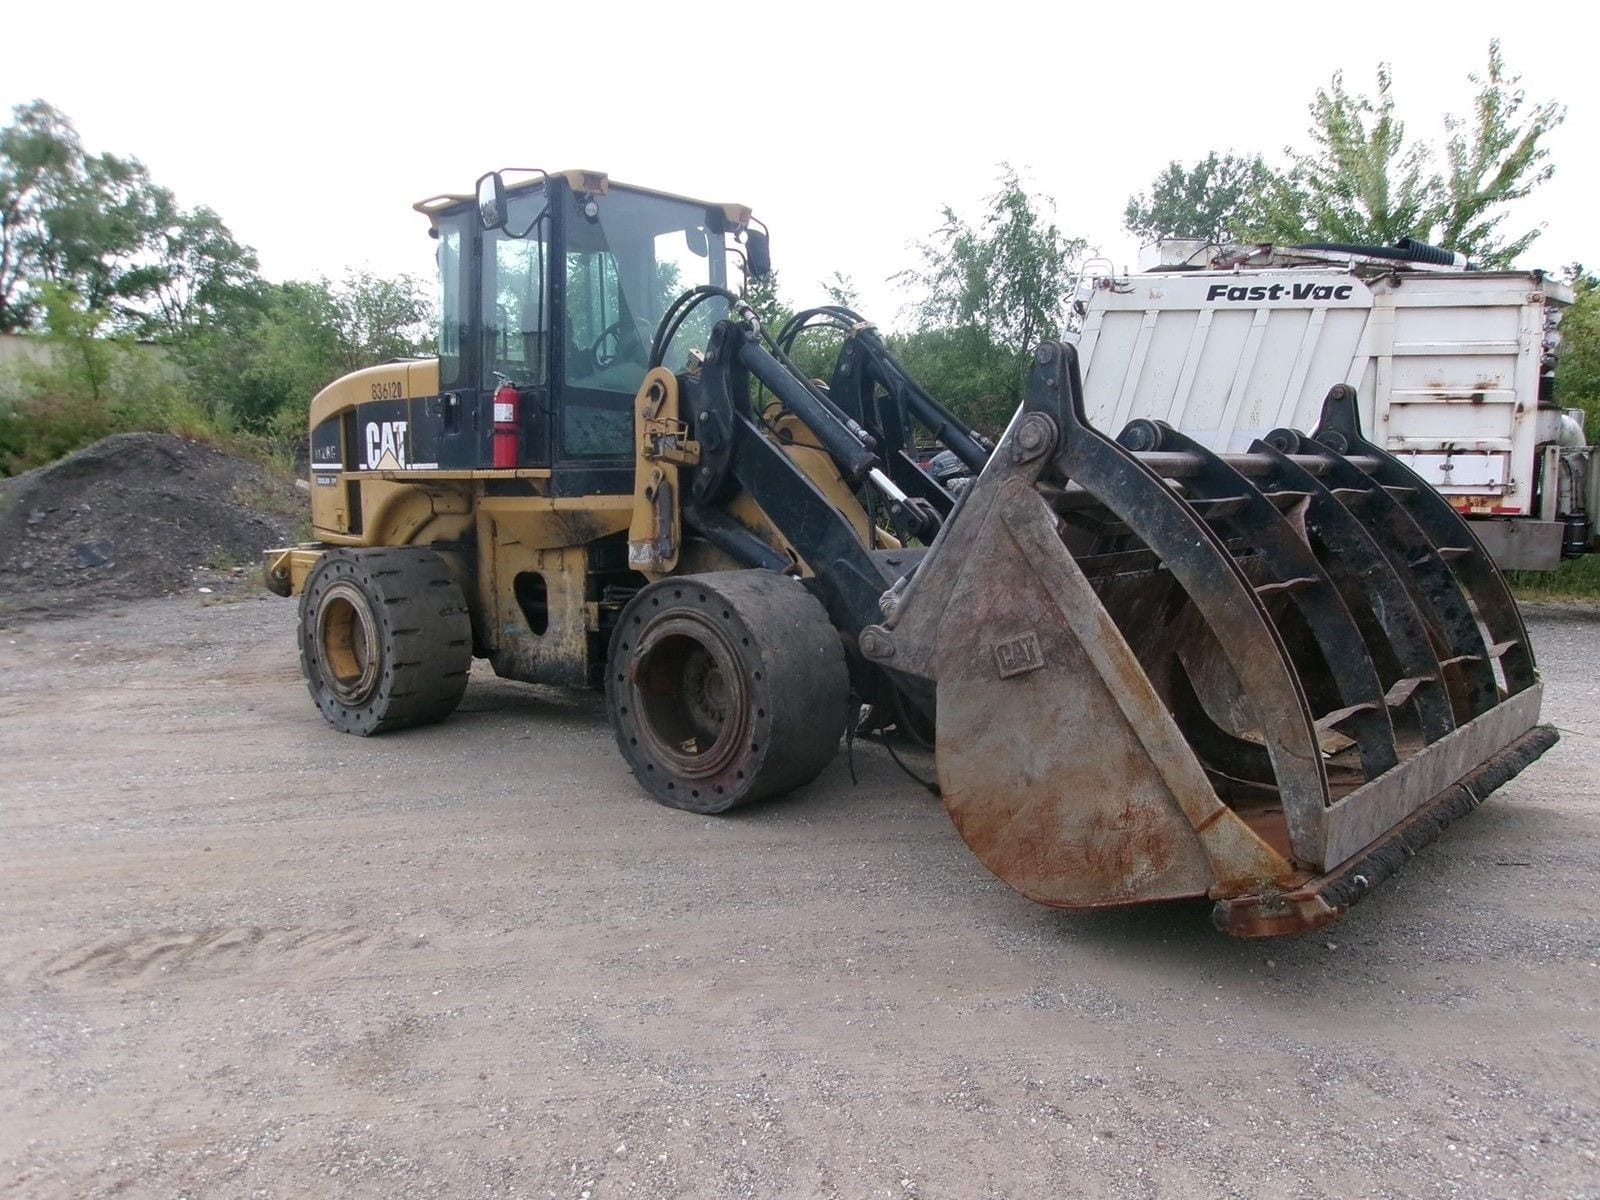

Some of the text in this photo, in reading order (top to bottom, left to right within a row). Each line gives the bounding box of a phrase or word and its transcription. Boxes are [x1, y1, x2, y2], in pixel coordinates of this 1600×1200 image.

[371, 382, 402, 400] 836120
[366, 422, 408, 470] CAT
[999, 637, 1038, 668] CAT
